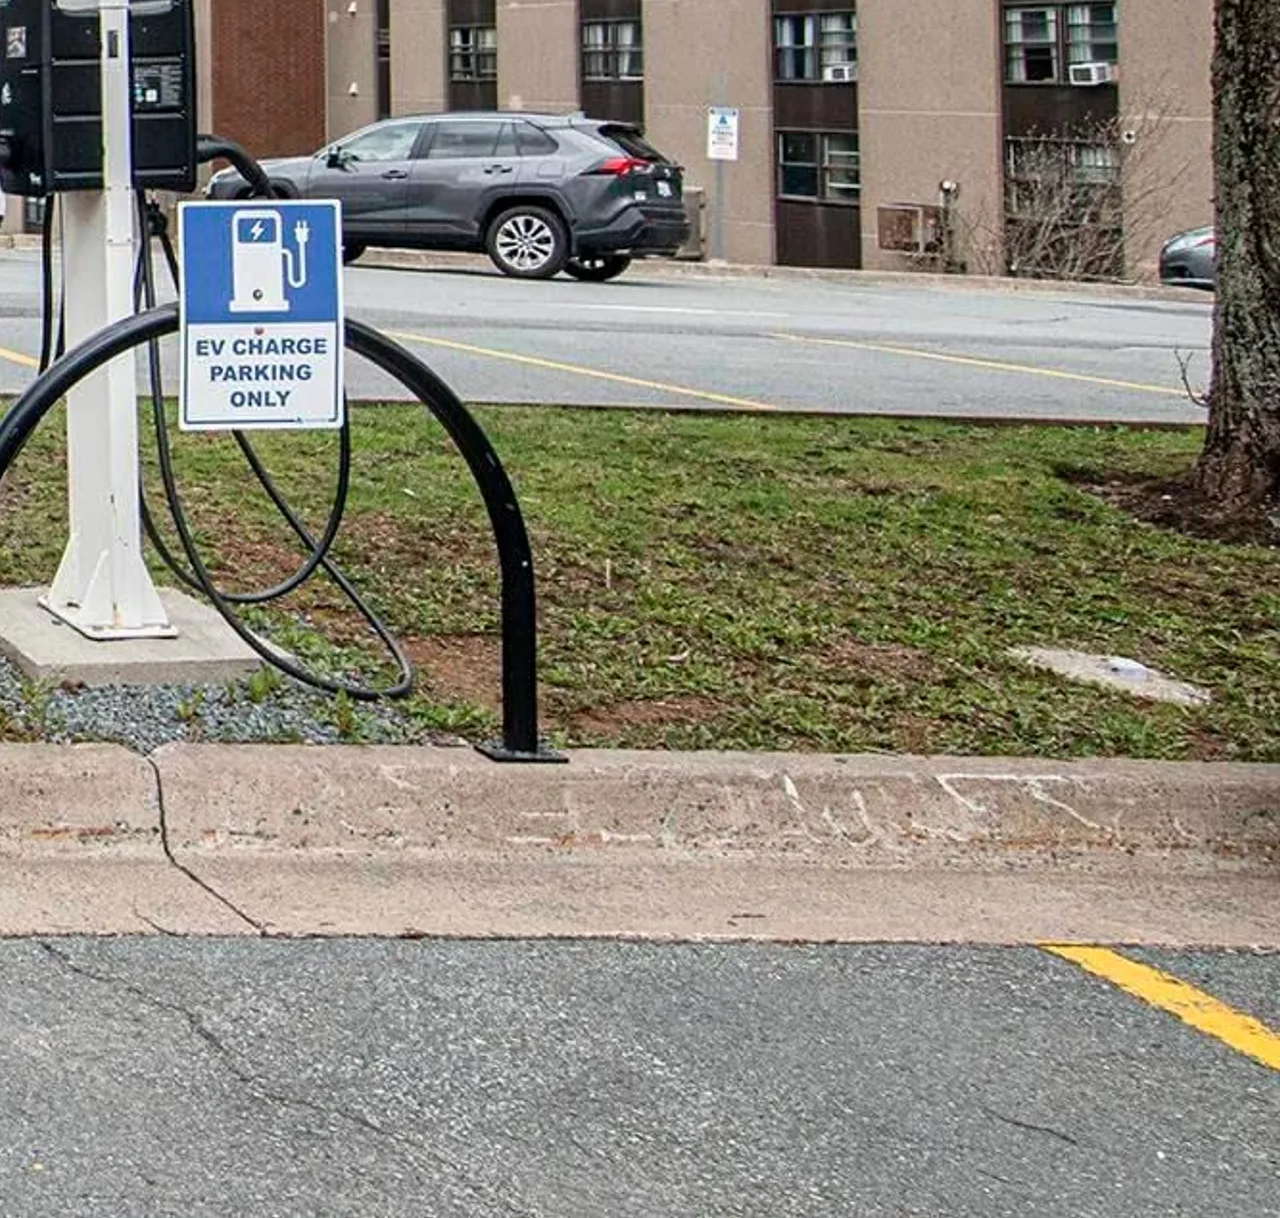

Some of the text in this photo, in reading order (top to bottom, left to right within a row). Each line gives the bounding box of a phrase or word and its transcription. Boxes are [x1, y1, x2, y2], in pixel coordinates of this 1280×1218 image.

[196, 338, 327, 356] EV CHARGE
[210, 364, 312, 381] PARKING
[230, 390, 291, 407] ONLY
